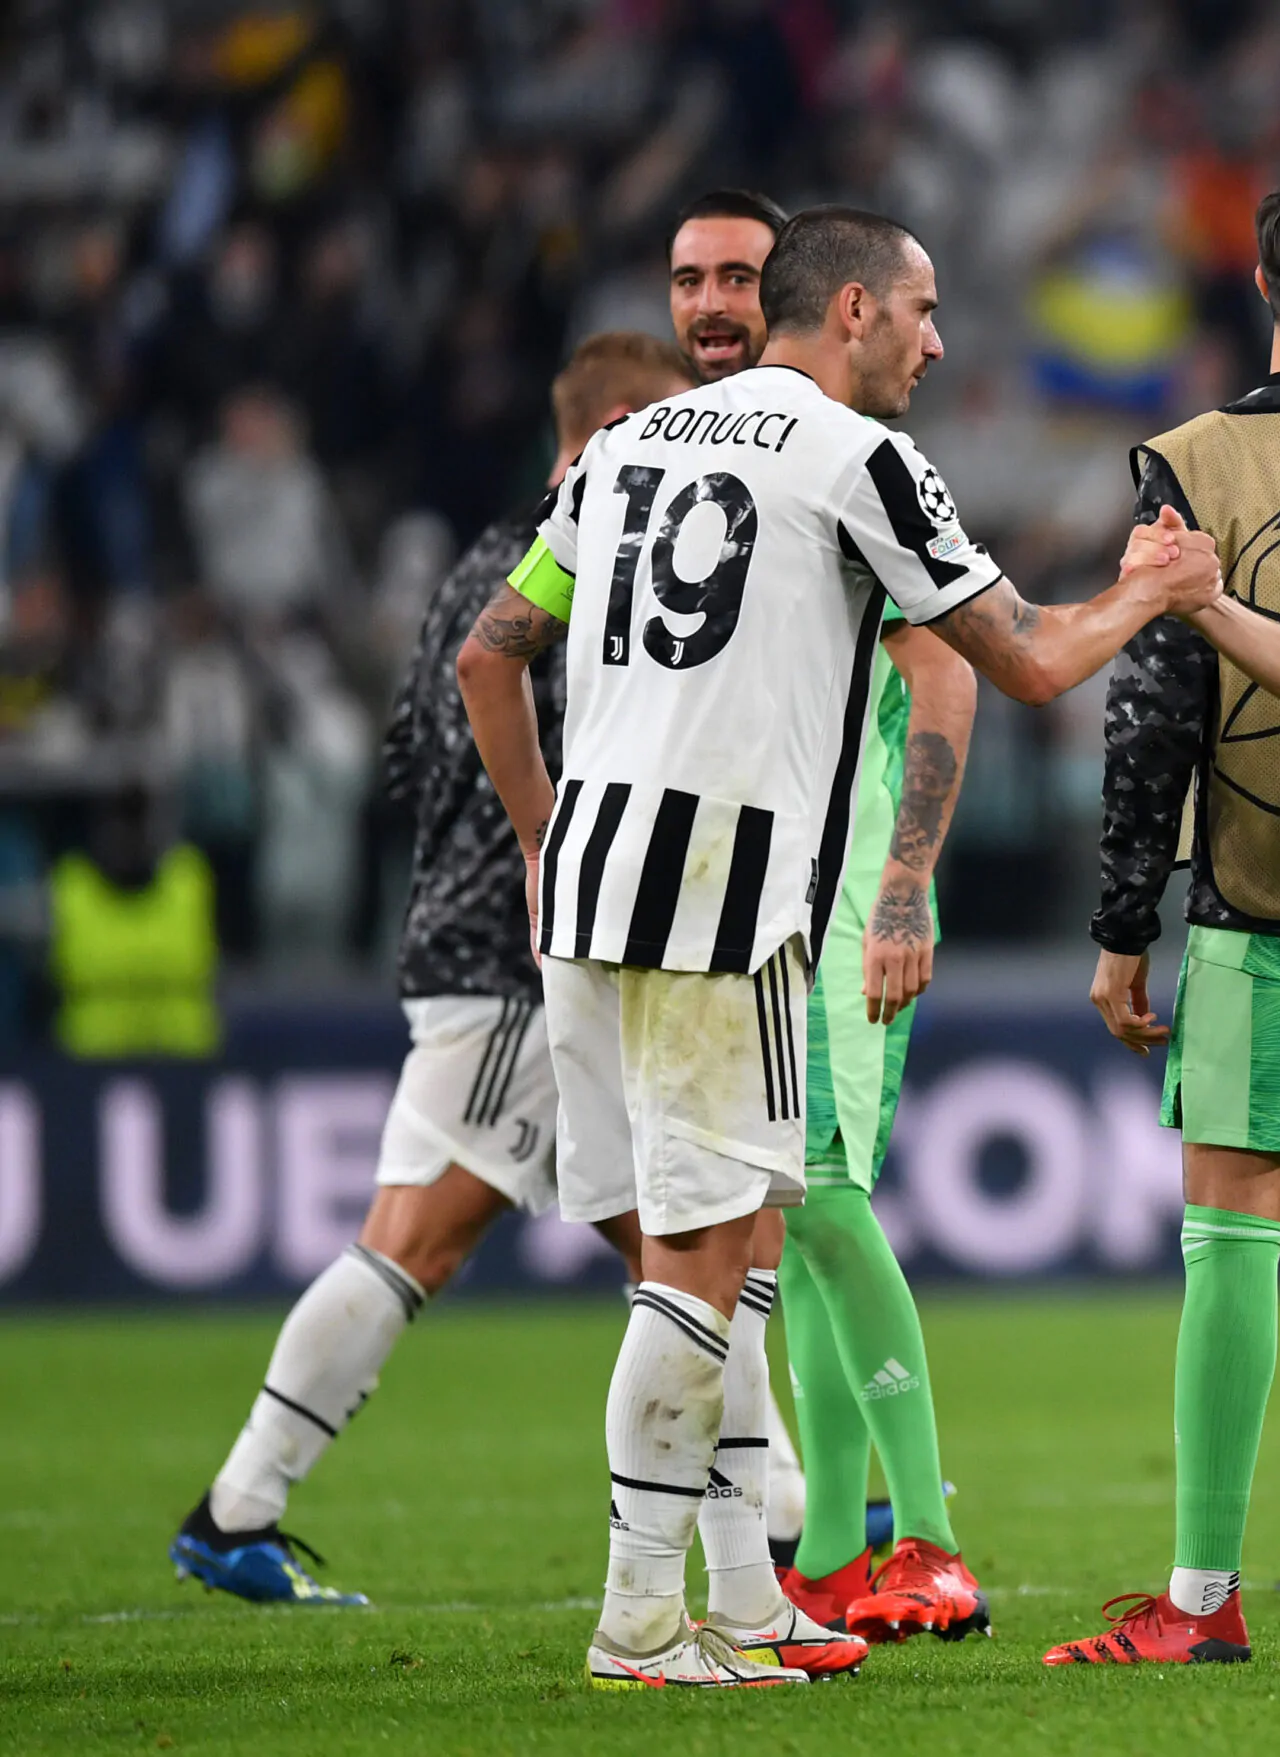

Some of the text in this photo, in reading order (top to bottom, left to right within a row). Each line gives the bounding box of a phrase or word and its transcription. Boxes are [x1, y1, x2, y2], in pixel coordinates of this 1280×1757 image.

[639, 407, 798, 452] BONUCCI
[603, 464, 758, 670] 19
[860, 1376, 919, 1402] adidas
